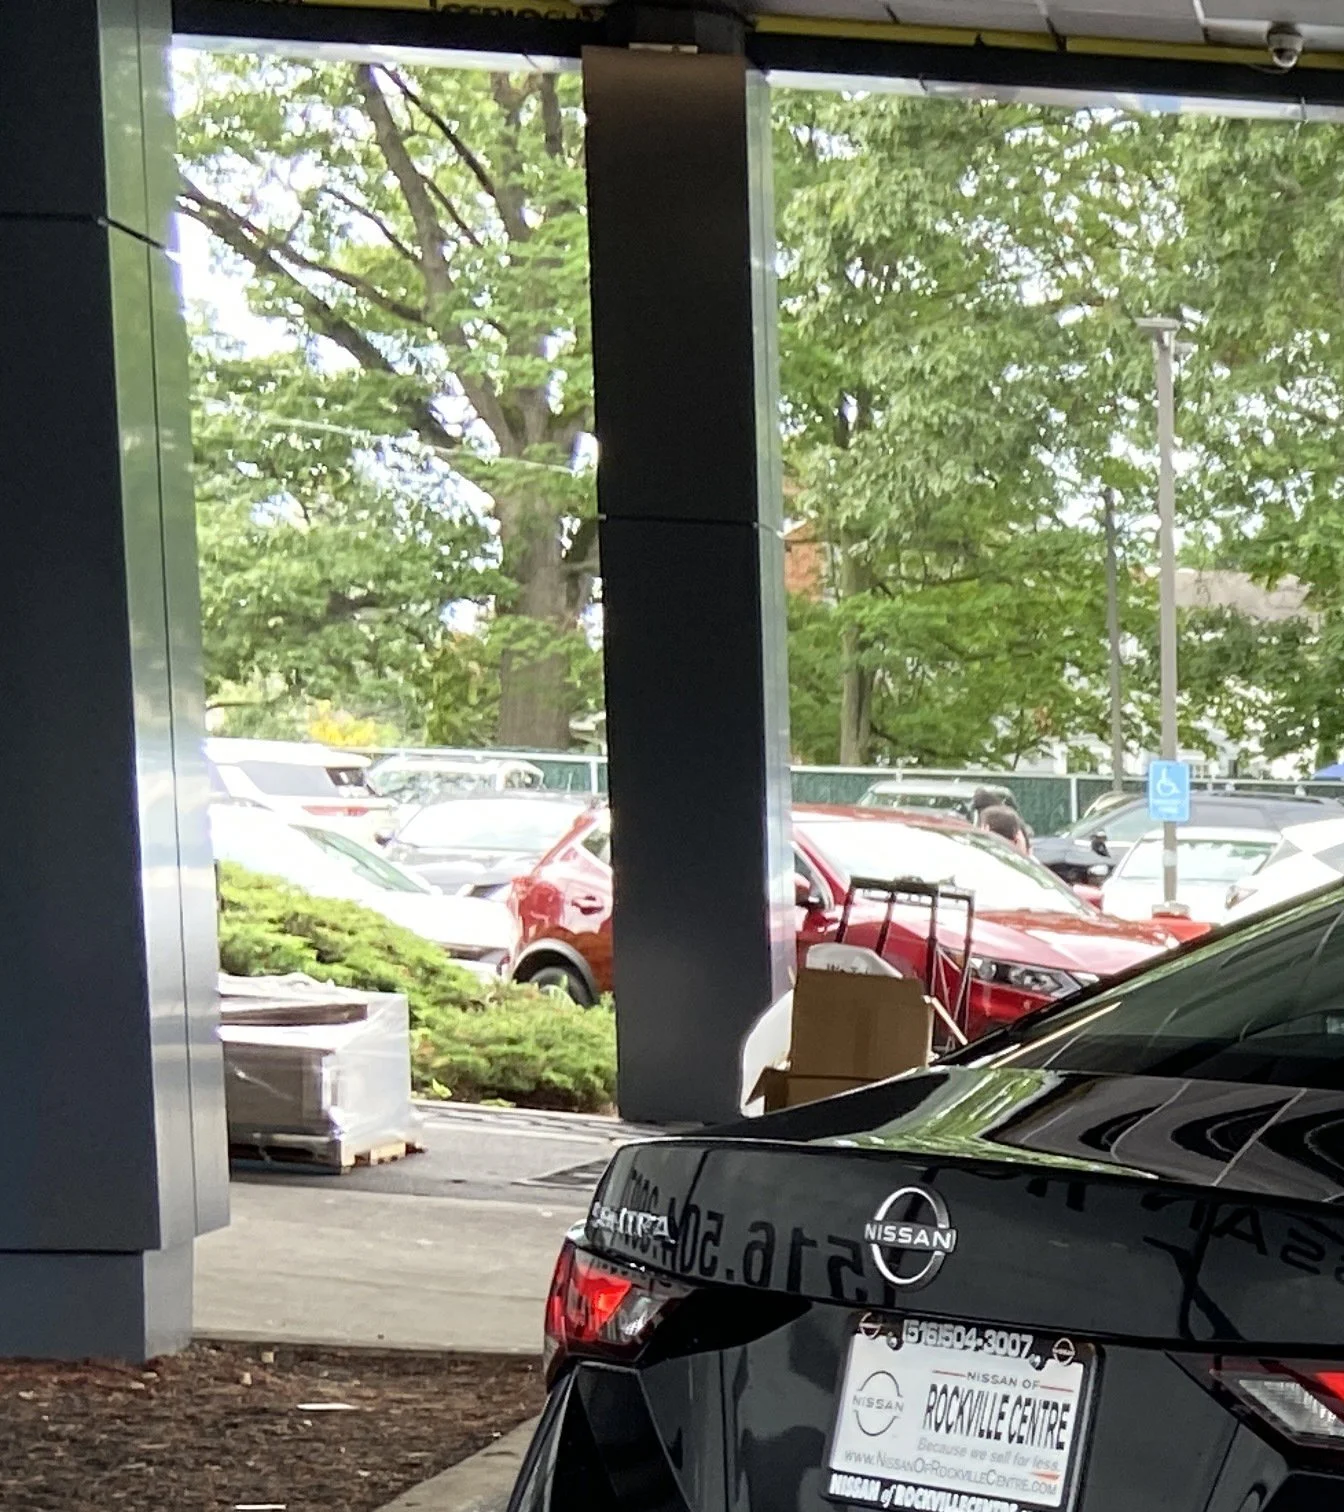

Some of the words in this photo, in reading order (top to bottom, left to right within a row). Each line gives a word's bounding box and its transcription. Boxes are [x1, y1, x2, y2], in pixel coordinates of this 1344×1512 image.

[864, 1223, 952, 1249] NISSAN
[966, 1371, 1018, 1387] NISSAN
[1022, 1379, 1040, 1389] OF
[853, 1395, 904, 1413] NISSAN
[922, 1384, 1009, 1441] ROCKVILLE
[1007, 1395, 1071, 1451] CENTRE
[917, 1437, 967, 1456] Because
[970, 1448, 988, 1460] we
[990, 1450, 1010, 1463] sell
[829, 1473, 882, 1502] NISSAN
[879, 1484, 896, 1508] of
